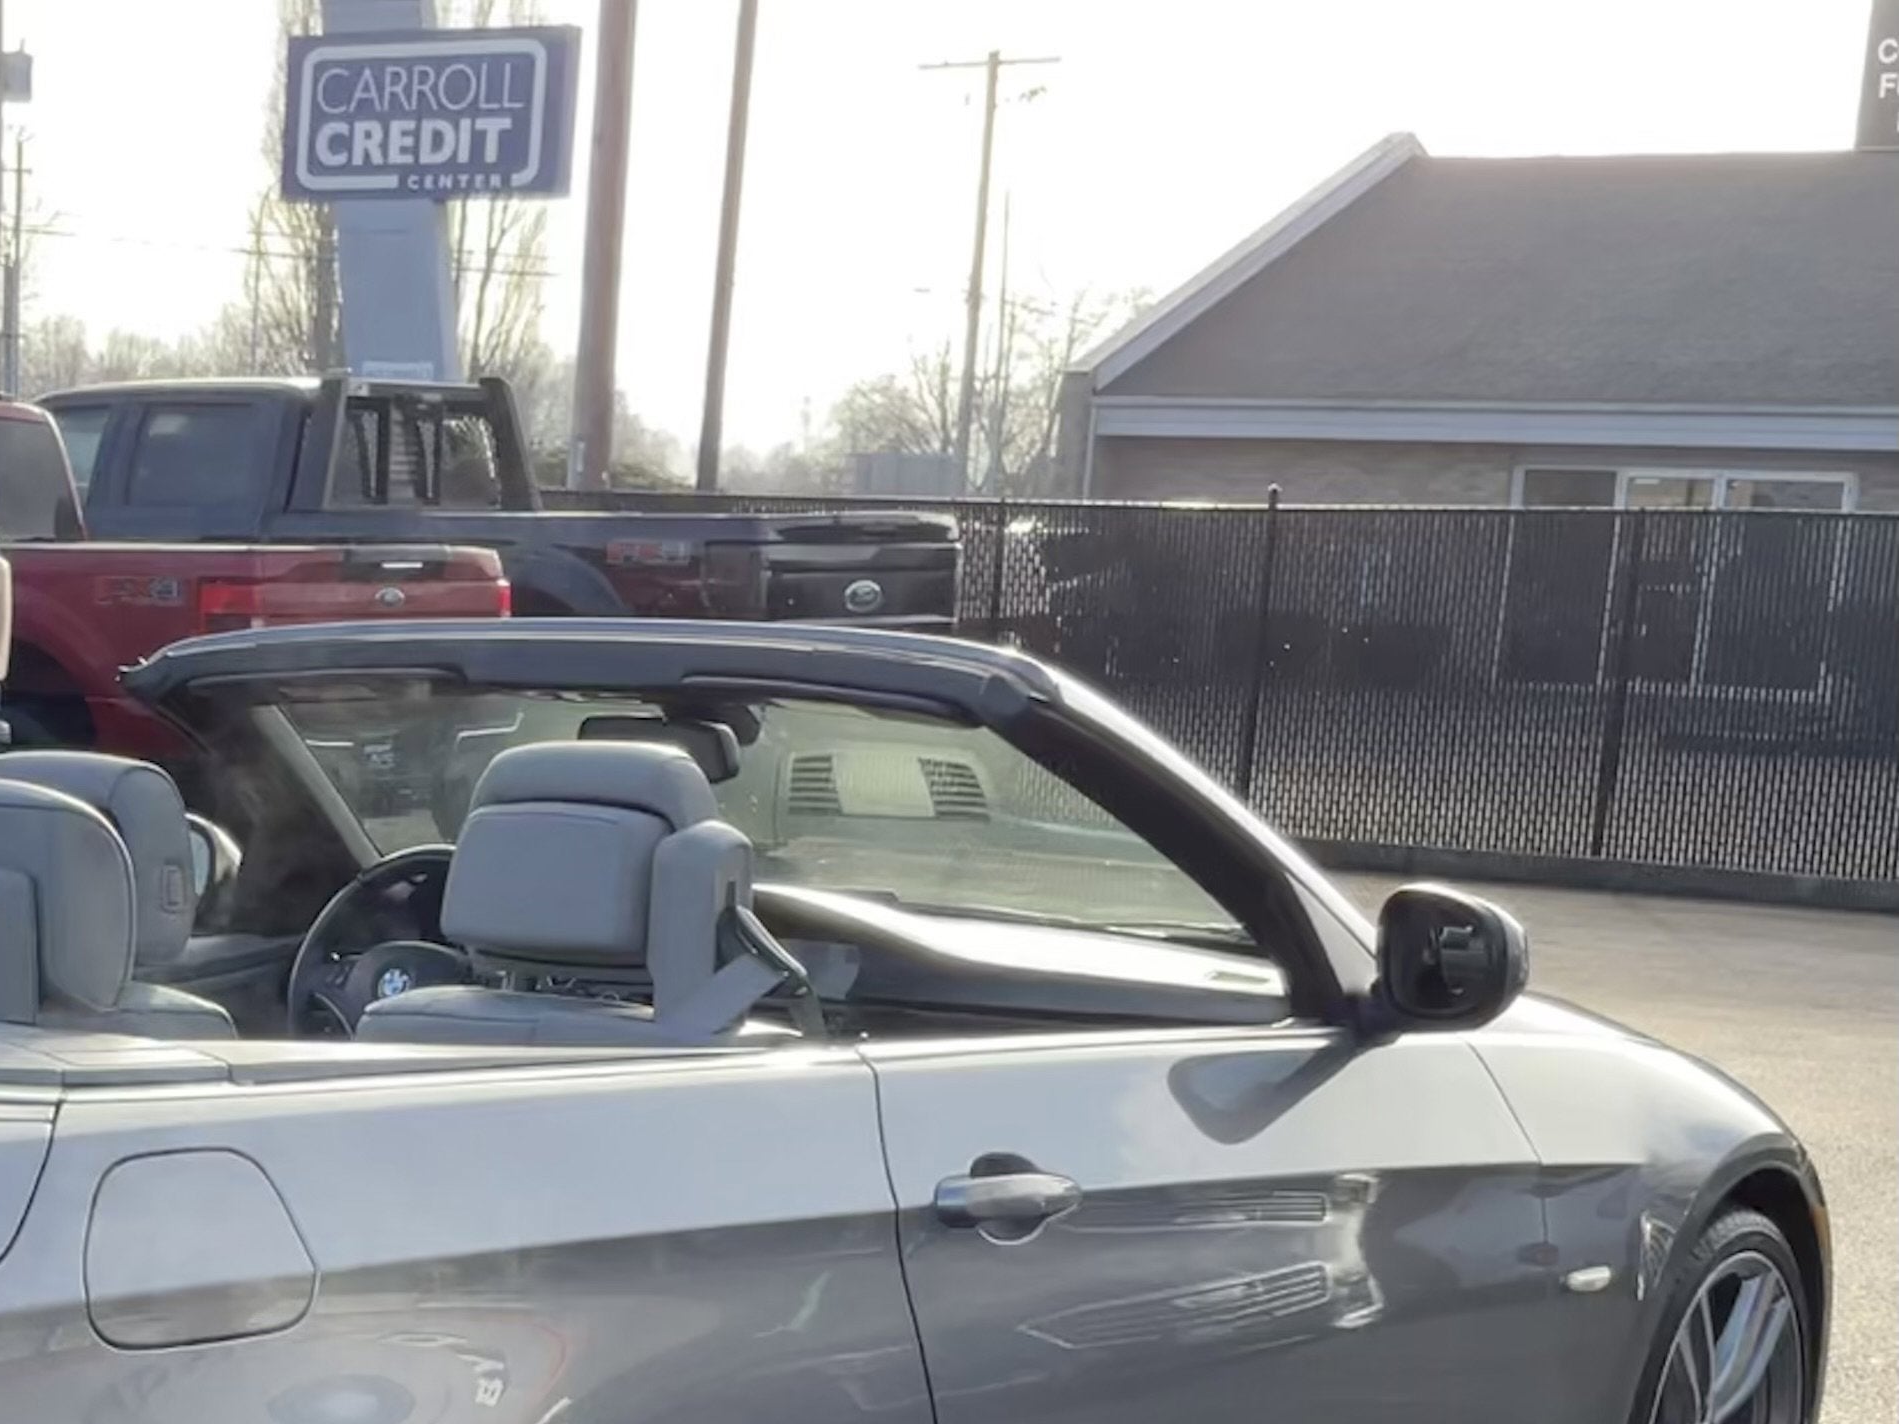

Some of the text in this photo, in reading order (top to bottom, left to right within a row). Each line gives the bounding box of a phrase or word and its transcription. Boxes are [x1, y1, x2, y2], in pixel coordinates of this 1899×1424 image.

[315, 62, 526, 114] CARROLL
[1878, 72, 1899, 98] F
[314, 118, 513, 167] CREDIT
[406, 173, 503, 190] CENTER
